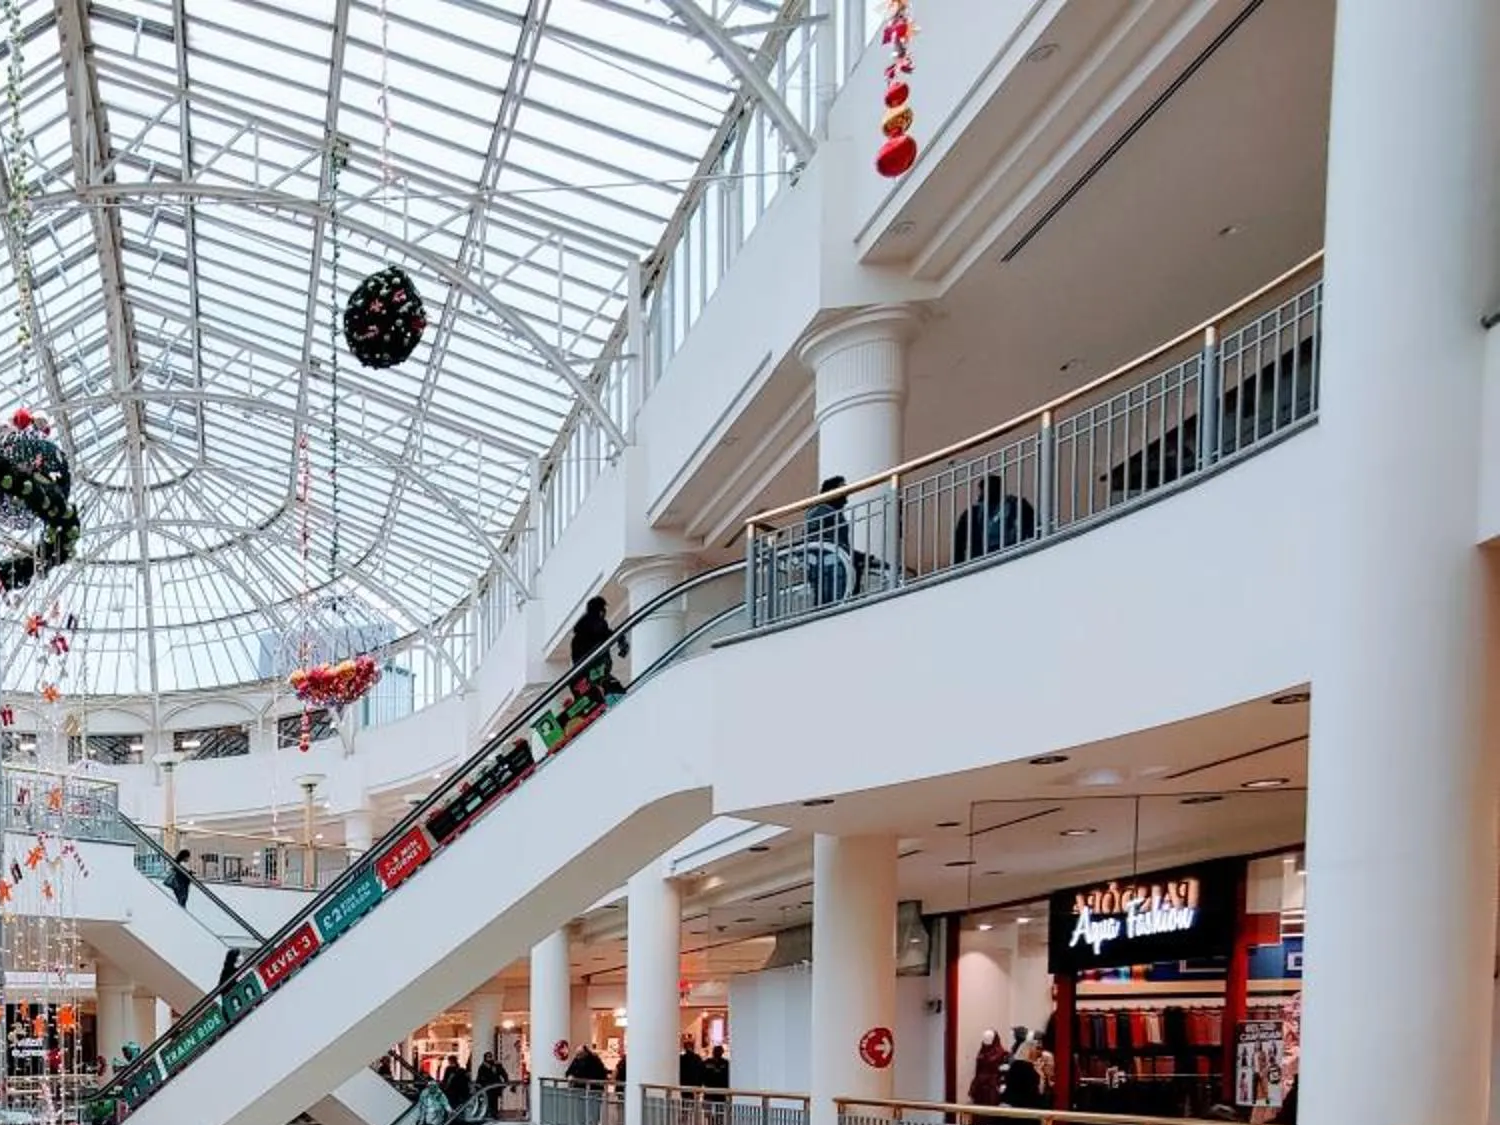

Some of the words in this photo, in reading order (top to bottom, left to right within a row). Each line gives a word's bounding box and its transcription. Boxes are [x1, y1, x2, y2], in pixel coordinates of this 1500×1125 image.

[1068, 905, 1121, 955] Aqua
[1126, 896, 1195, 938] Fashion
[266, 947, 300, 979] LEVEL
[300, 935, 311, 948] 3
[165, 1035, 197, 1065] TRAIN
[197, 1013, 222, 1039] RIDE
